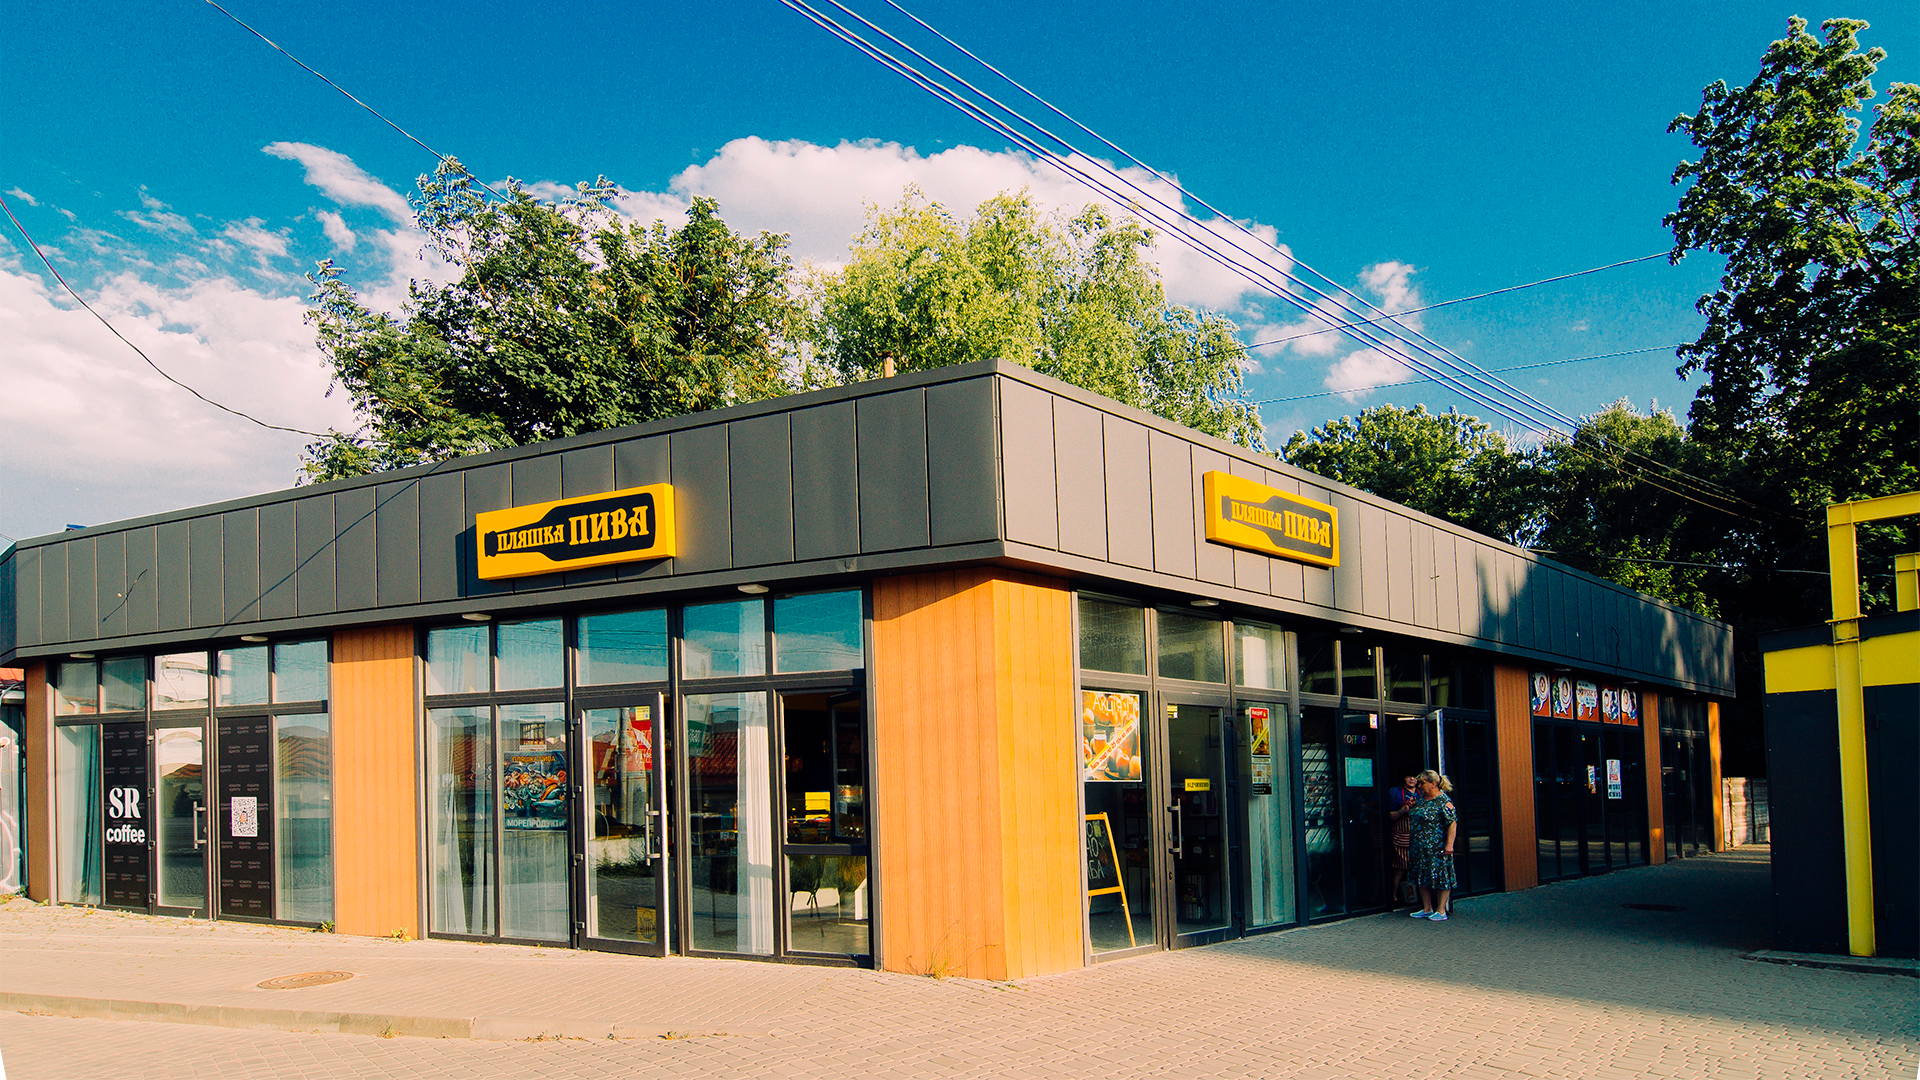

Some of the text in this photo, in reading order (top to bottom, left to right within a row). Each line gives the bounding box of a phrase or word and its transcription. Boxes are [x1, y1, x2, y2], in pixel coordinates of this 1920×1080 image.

[497, 505, 650, 552] ПЛЯШКА ПИВА
[1231, 501, 1331, 548] ПЛЯШКА ПИВА
[109, 787, 141, 819] SR
[106, 824, 145, 843] coffee
